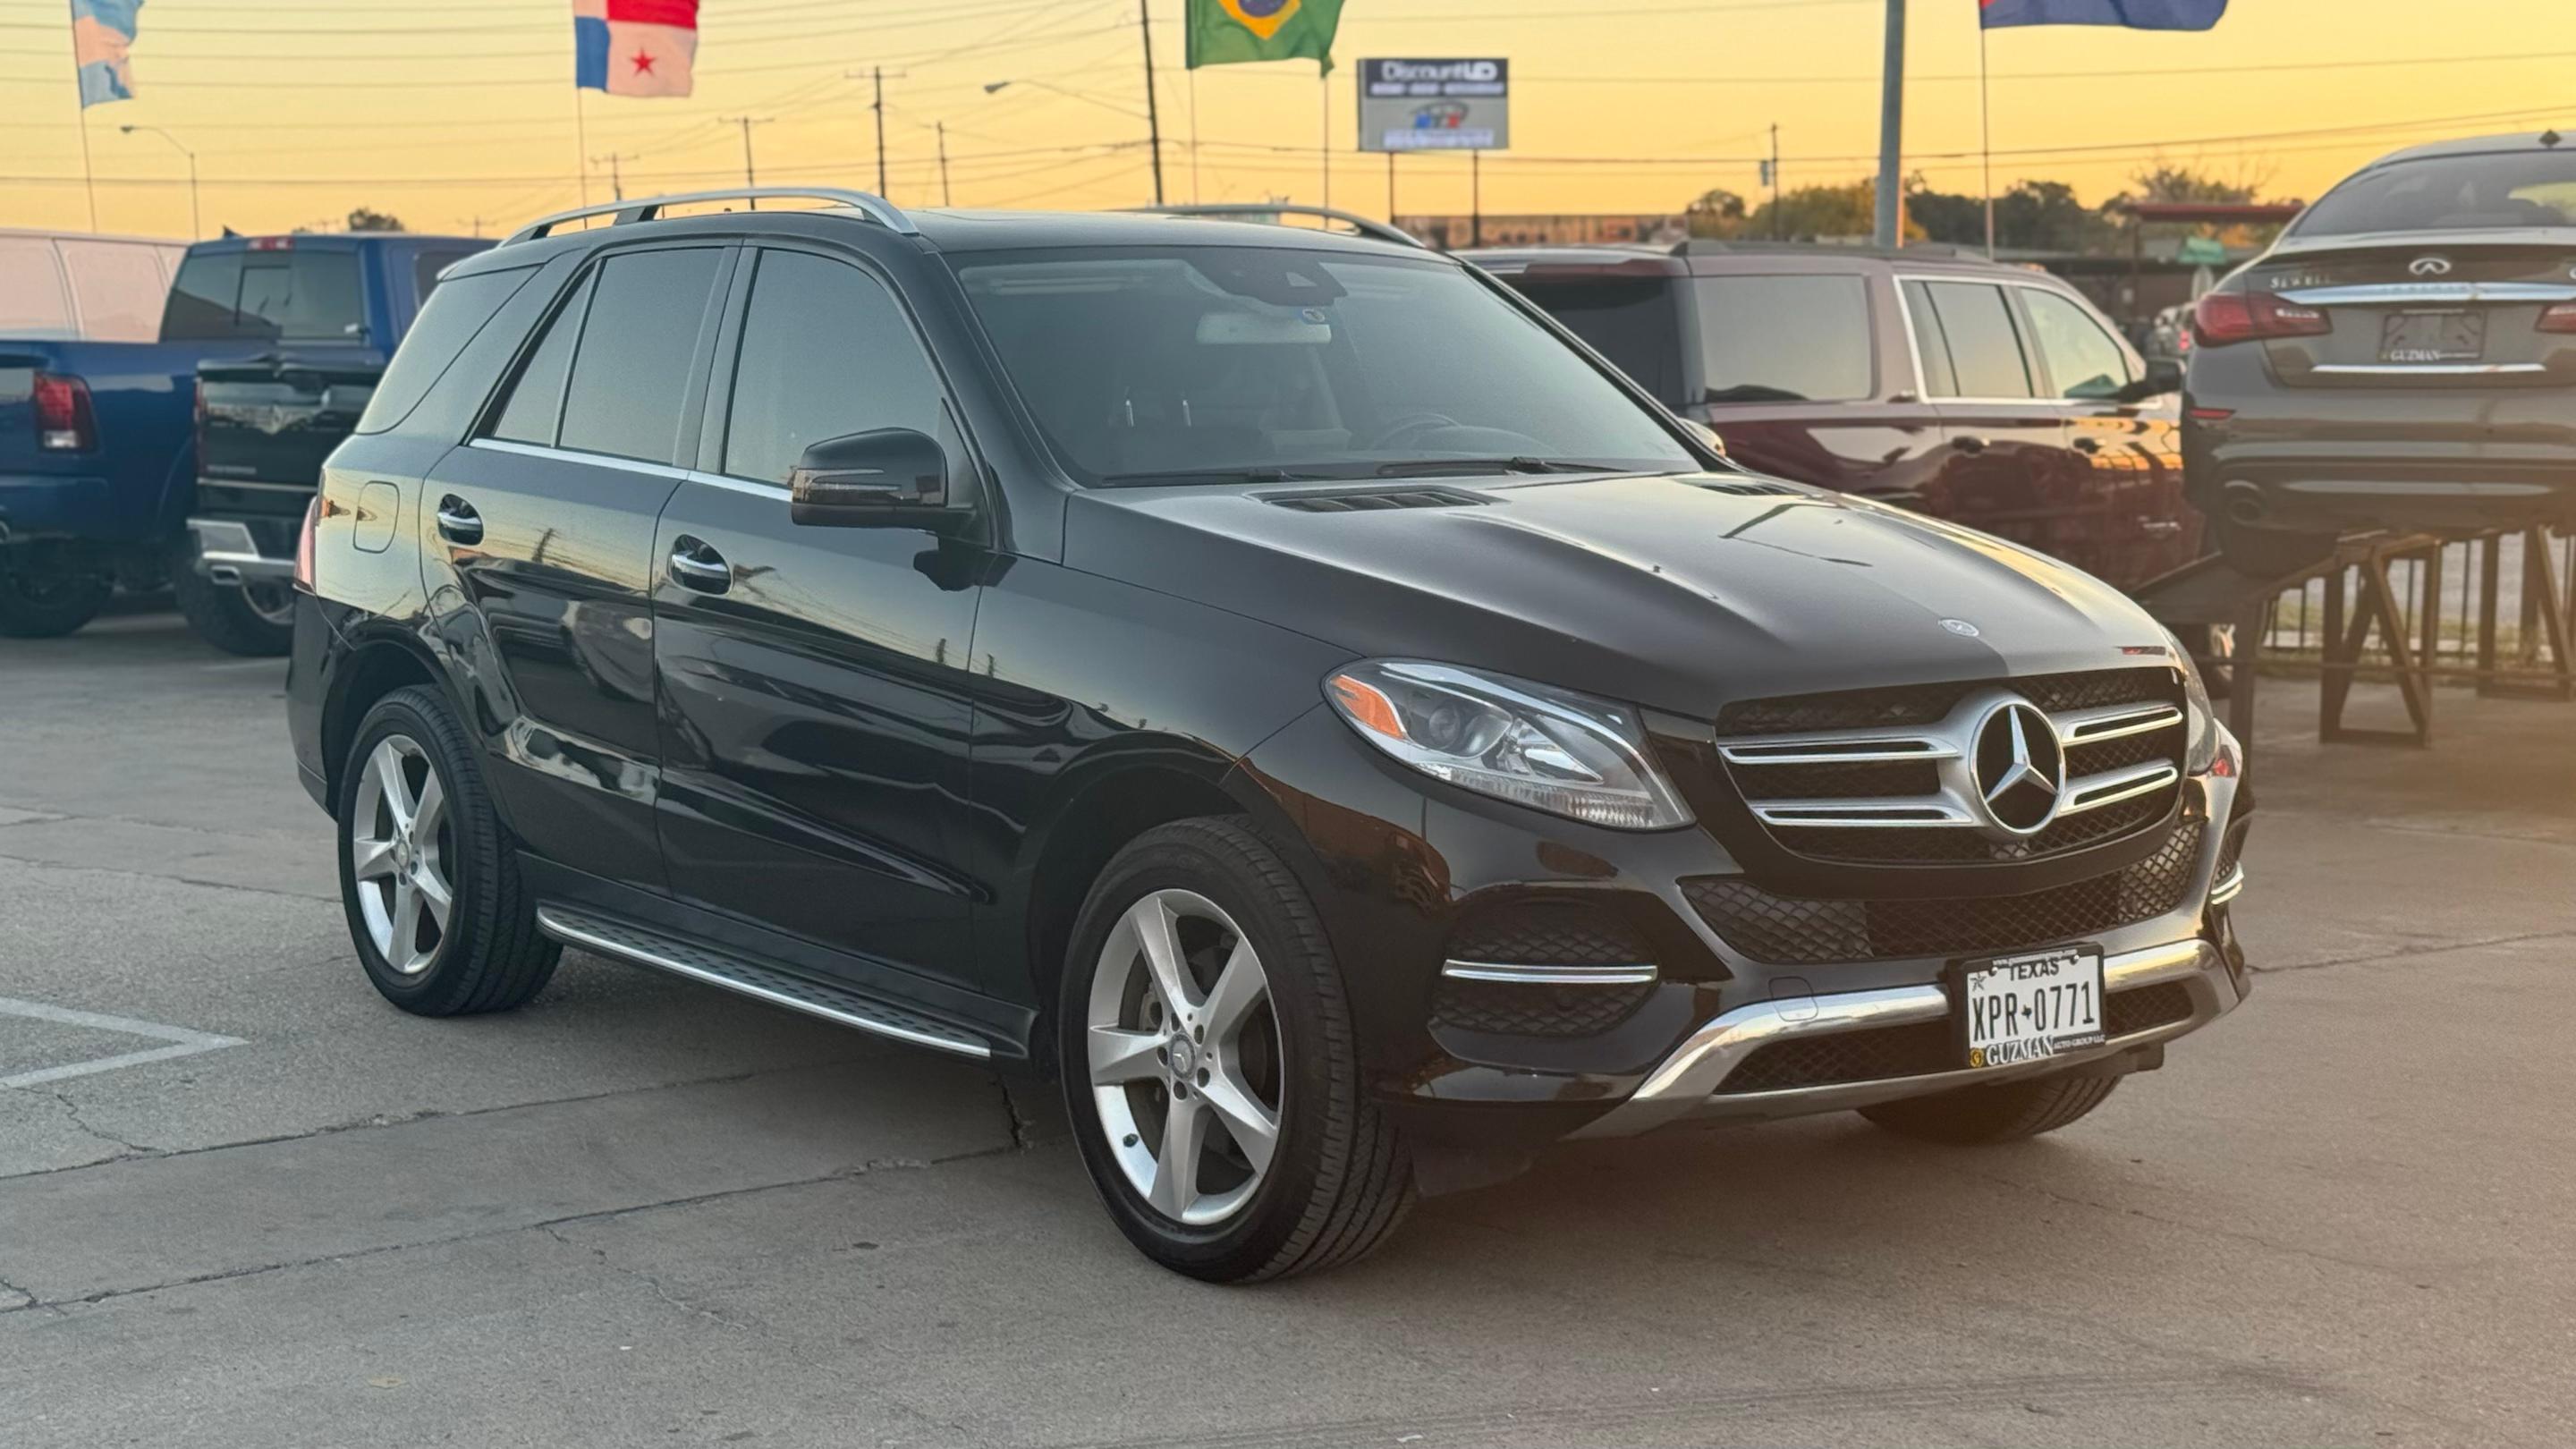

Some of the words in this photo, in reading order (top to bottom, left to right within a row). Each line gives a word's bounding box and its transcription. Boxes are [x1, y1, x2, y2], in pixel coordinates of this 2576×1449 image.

[2010, 958, 2060, 981] TEXAS
[1972, 992, 2019, 1042] XPR
[2034, 980, 2095, 1032] 0771
[1986, 1036, 2054, 1066] GUZMAN
[2072, 1037, 2093, 1047] GROUP
